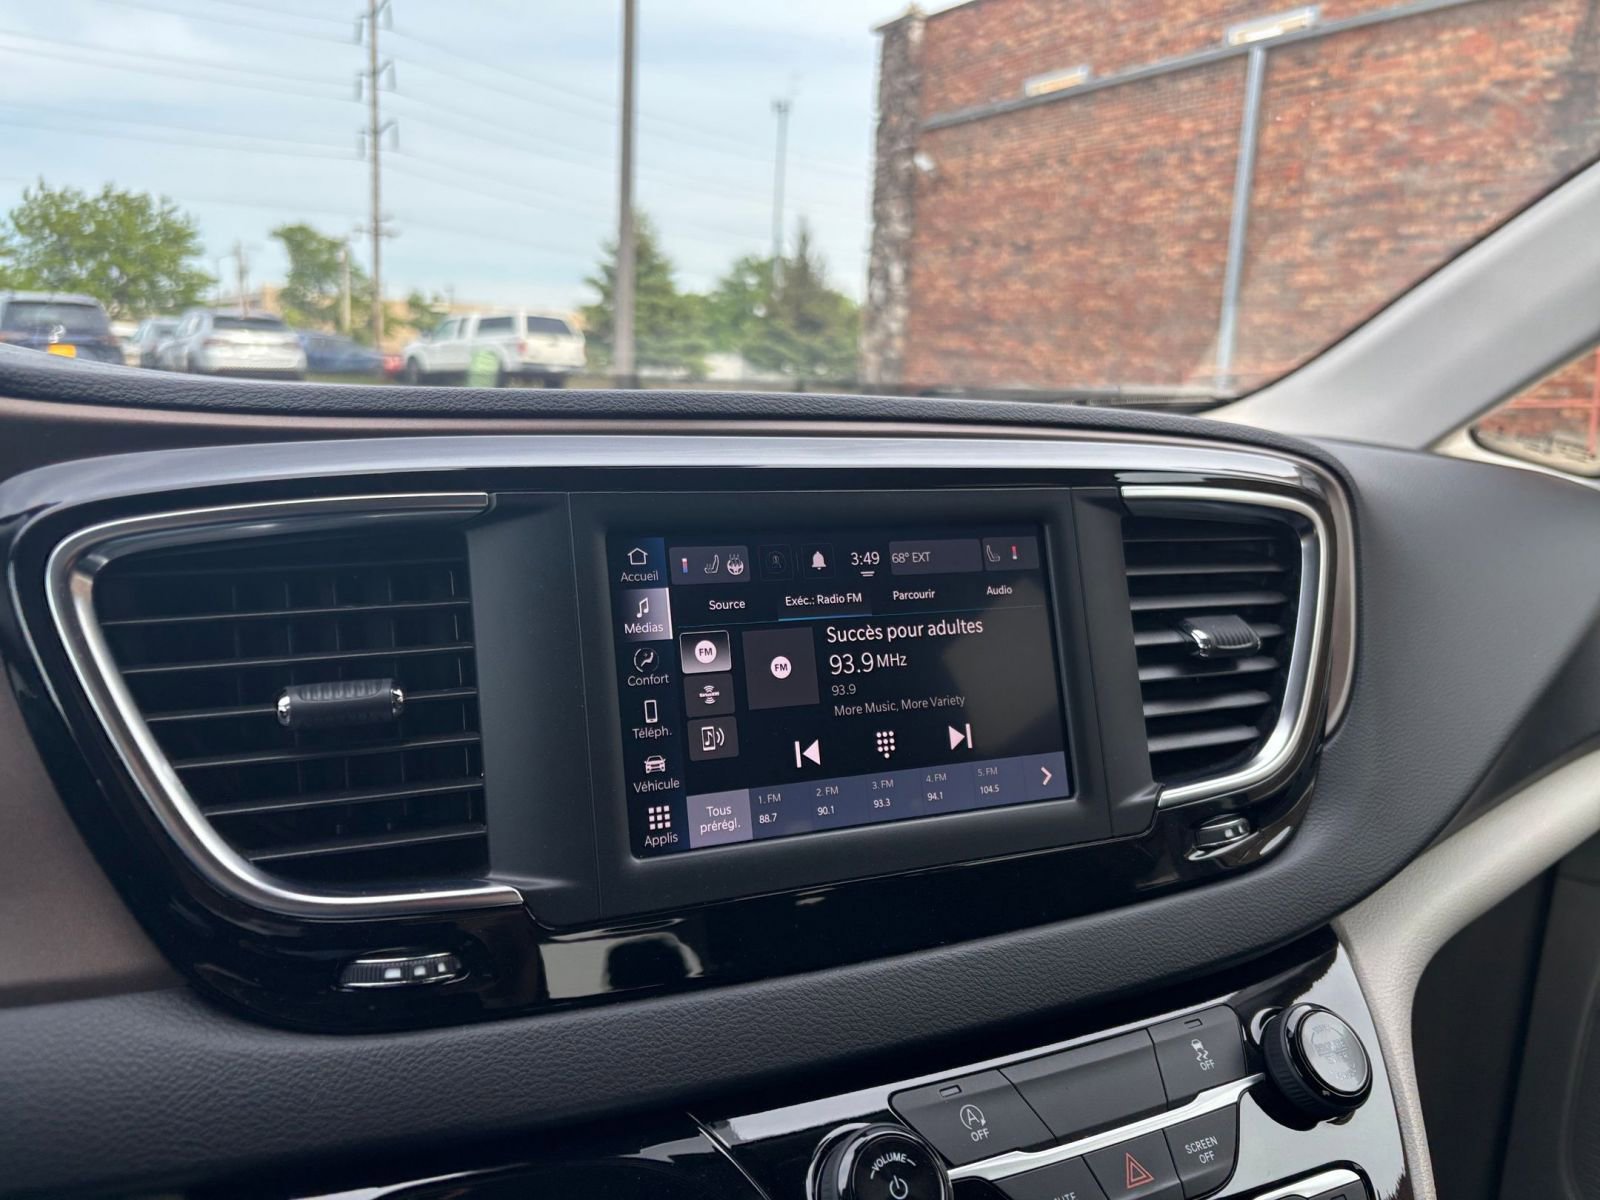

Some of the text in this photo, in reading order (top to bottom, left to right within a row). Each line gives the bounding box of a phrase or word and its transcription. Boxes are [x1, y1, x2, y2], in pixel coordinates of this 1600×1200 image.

[850, 551, 880, 566] 3:49
[891, 551, 931, 563] 68° EXT
[620, 571, 660, 582] Accueil
[892, 589, 936, 601] Parcourir
[986, 585, 1013, 596] Audio
[708, 600, 746, 611] Source
[785, 592, 862, 607] Exéc.: Radio FM
[624, 623, 664, 635] Médias
[826, 618, 984, 644] Succès pour adultes
[698, 647, 714, 657] FM
[774, 662, 789, 673] FM
[829, 652, 908, 676] 93.9 MHz
[627, 675, 670, 687] Confort
[831, 684, 857, 697] 93.9
[834, 695, 966, 717] More Music, More Variety
[632, 727, 673, 740] Téléph.
[934, 773, 947, 783] FM
[986, 767, 998, 777] FM
[633, 779, 681, 793] Véhicule
[825, 785, 839, 796] FM
[881, 779, 894, 790] FM
[979, 784, 1000, 795] 104.5
[758, 793, 782, 804] 1. FM
[927, 791, 944, 802] 94.1
[873, 798, 891, 809] 93.3
[706, 805, 732, 817] Tous
[817, 805, 835, 816] 90.1
[759, 812, 778, 824] 88.7
[700, 819, 741, 835] prérégl.
[644, 832, 679, 847] Applis
[1200, 1059, 1216, 1071] OFF
[970, 1129, 990, 1142] OFF
[1184, 1135, 1218, 1155] SCREEN
[871, 1152, 907, 1172] VOLUME
[1199, 1150, 1215, 1164] OFF
